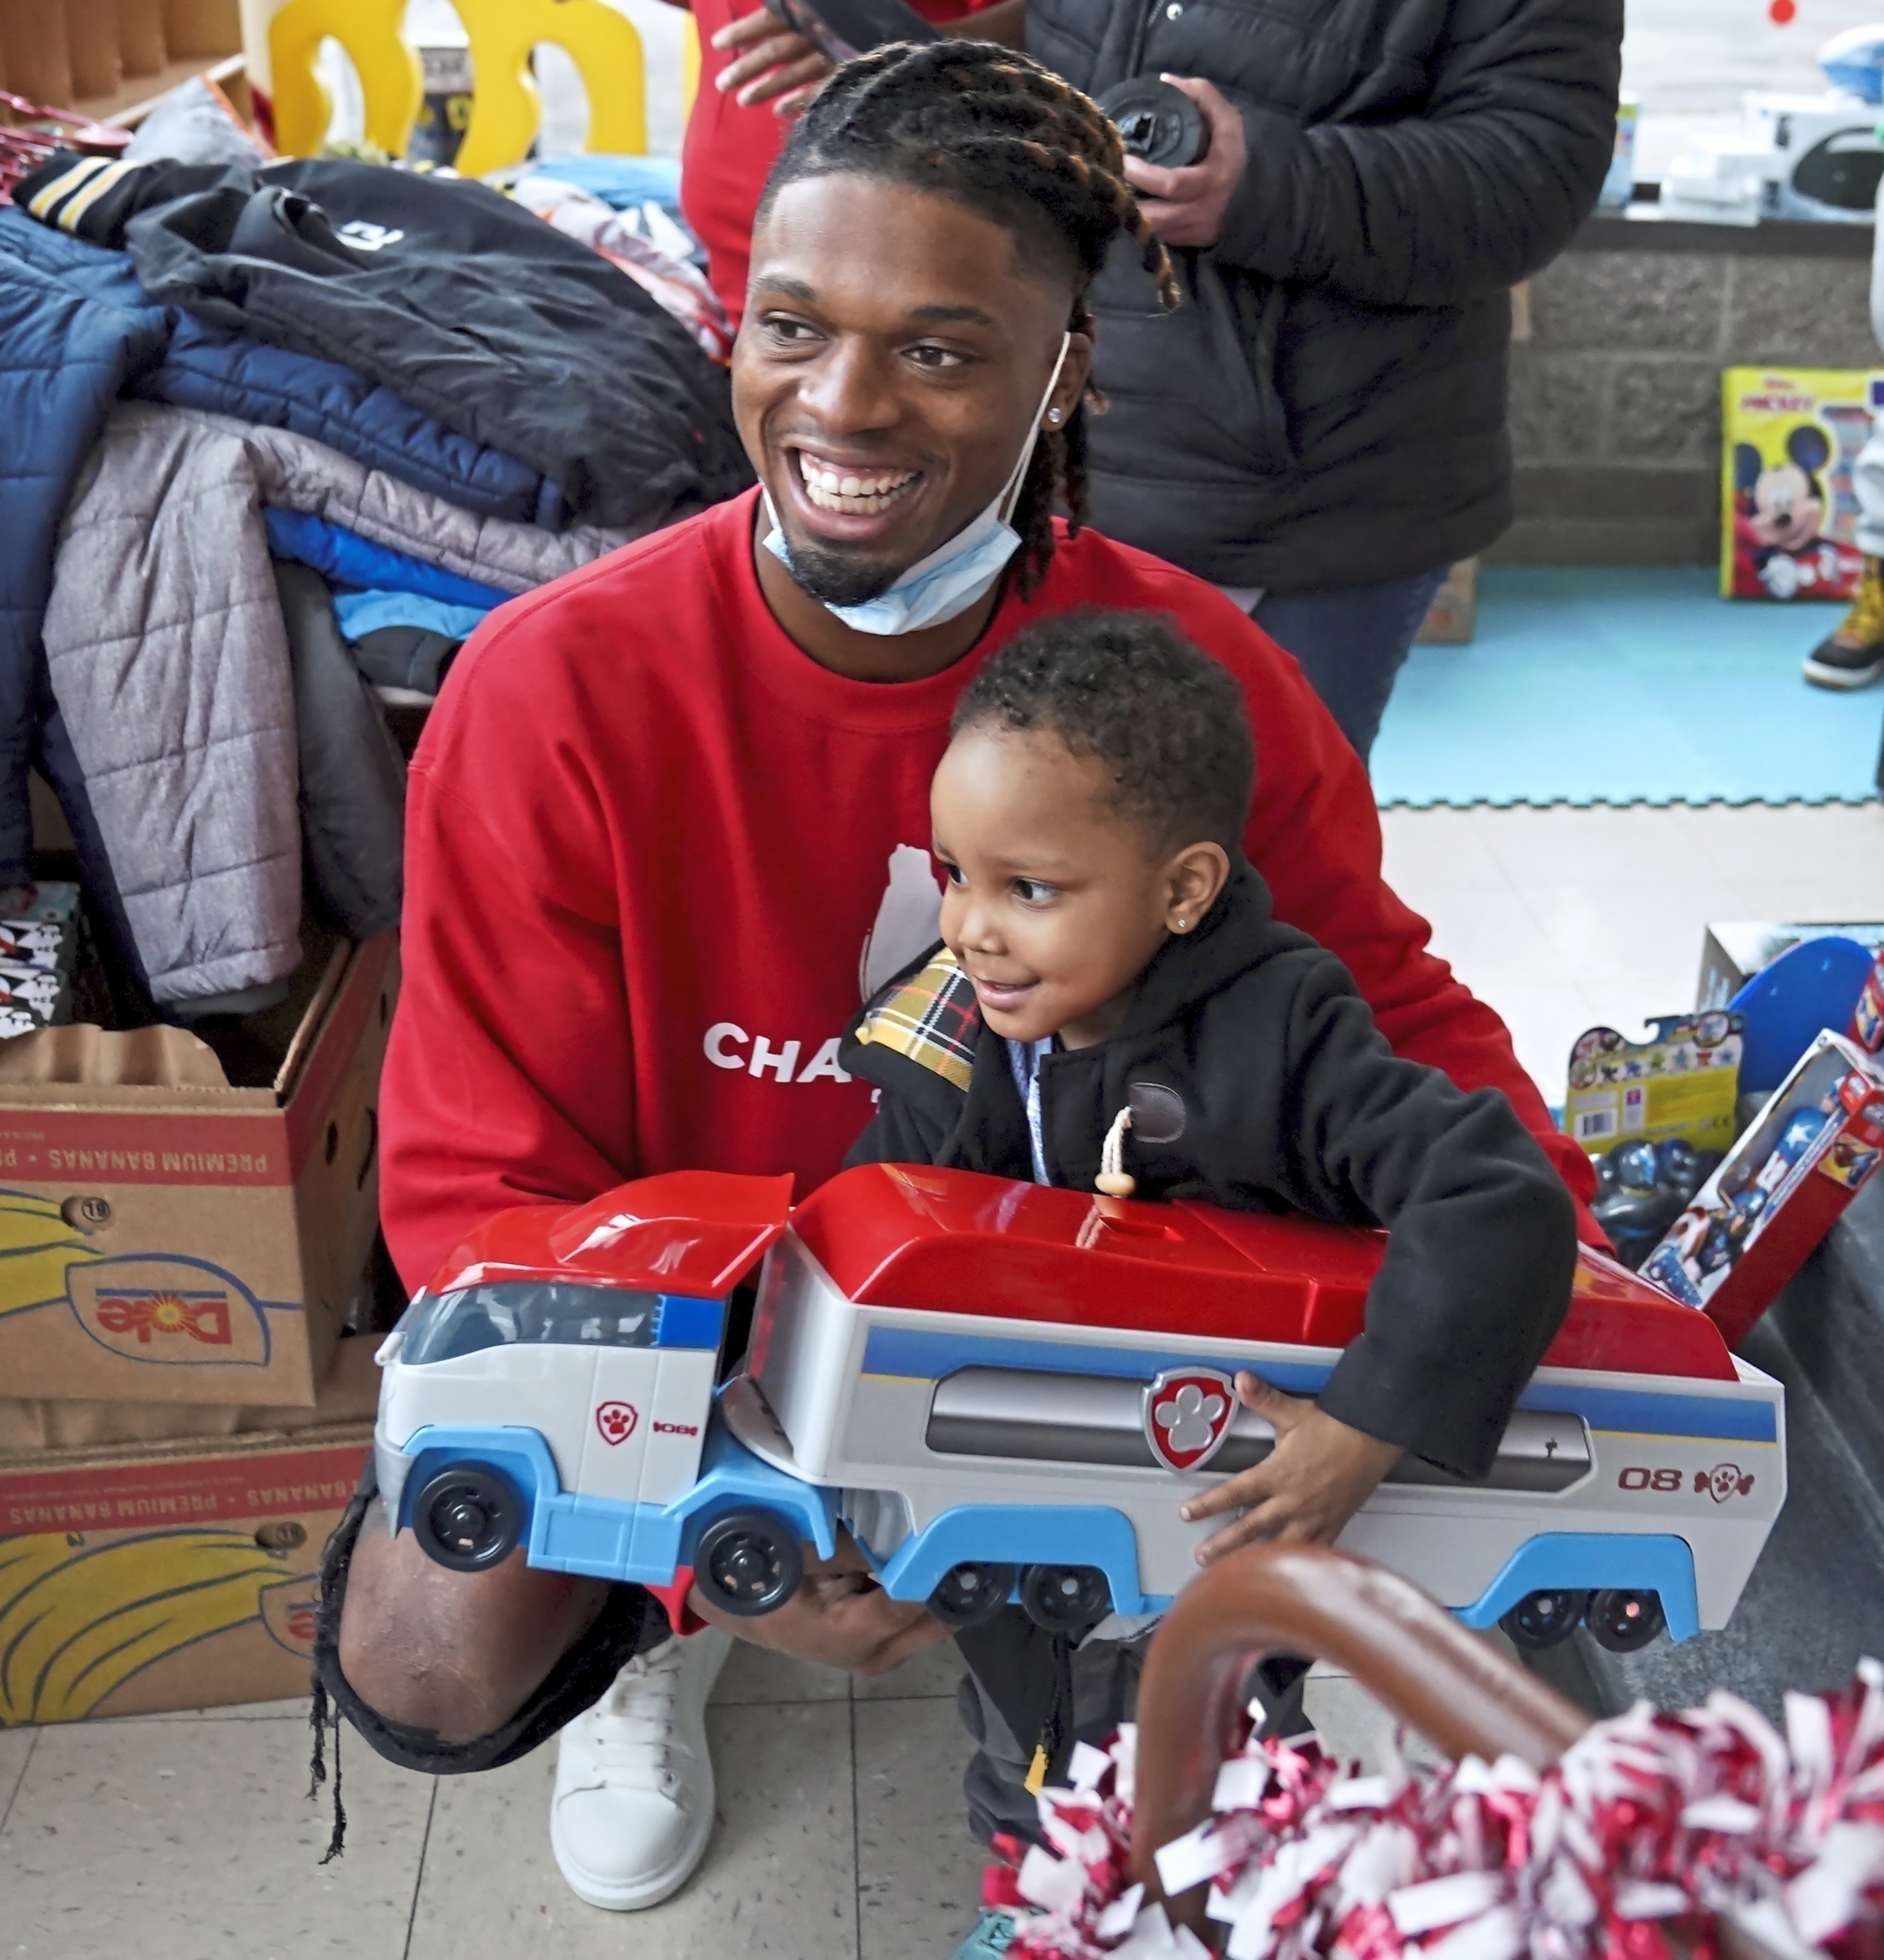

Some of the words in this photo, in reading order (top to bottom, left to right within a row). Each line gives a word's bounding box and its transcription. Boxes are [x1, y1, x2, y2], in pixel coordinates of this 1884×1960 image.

[47, 1149, 155, 1170] BANANAS
[161, 1153, 268, 1173] PREMIUM
[96, 1296, 232, 1345] Dole
[1618, 1467, 1683, 1492] 08
[118, 1493, 217, 1517] PREMIUM
[247, 1480, 346, 1507] BANANAS
[9, 1501, 112, 1524] BANANAS
